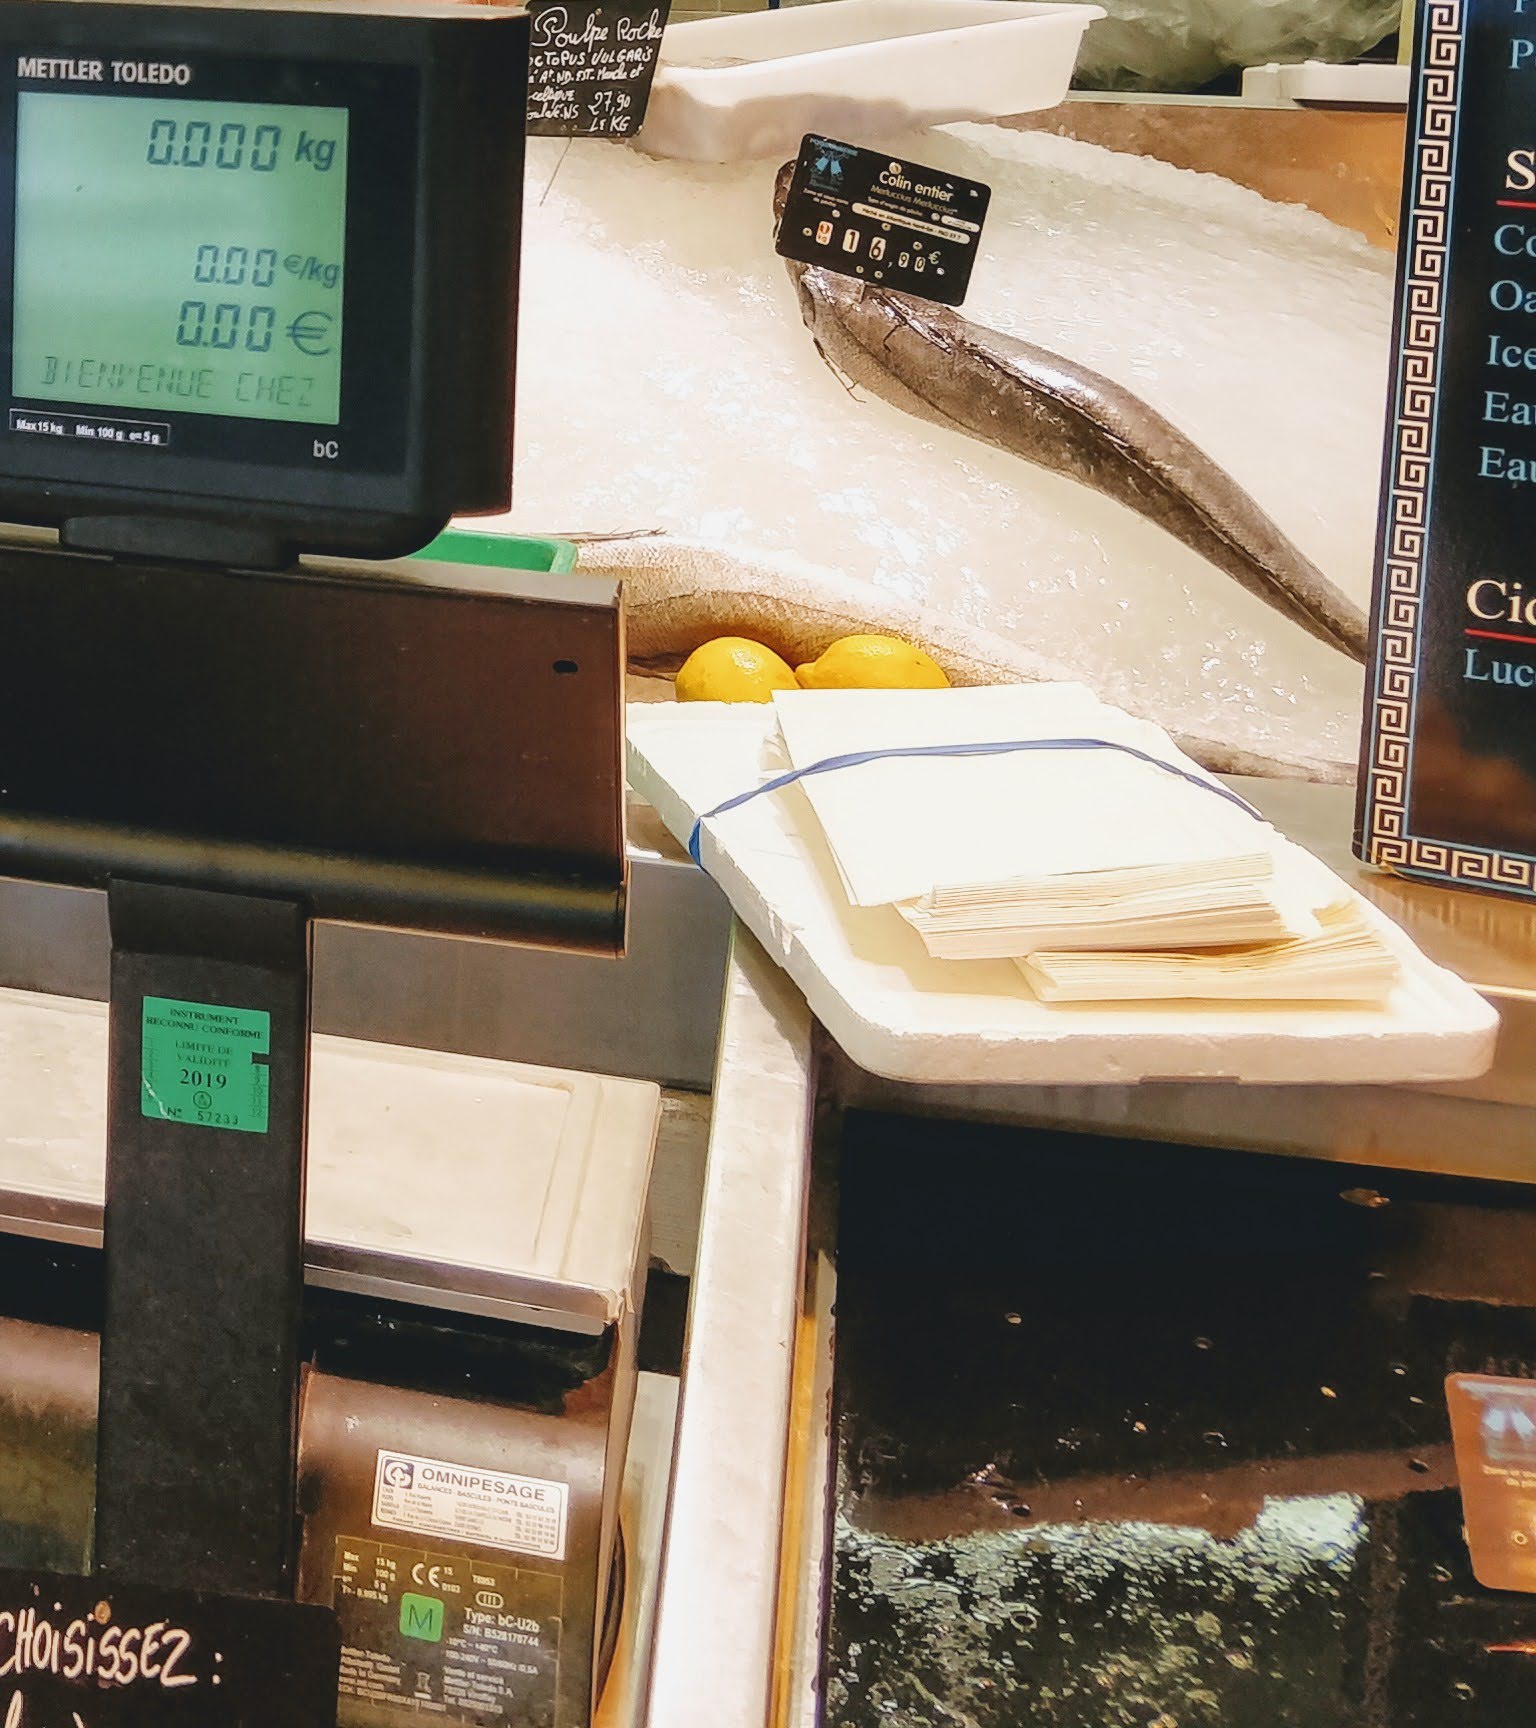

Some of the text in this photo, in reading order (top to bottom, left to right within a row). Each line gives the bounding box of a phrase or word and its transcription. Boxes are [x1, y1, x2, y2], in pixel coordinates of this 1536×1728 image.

[531, 6, 609, 53] Poulpe
[17, 57, 191, 86] METTLER TOLEDO
[588, 91, 631, 115] 27,90
[147, 119, 337, 172] 0.000 kg
[879, 171, 954, 203] Colin entier
[194, 244, 341, 290] 0.00 €/kg
[176, 301, 333, 356] 0.00 €
[1486, 335, 1536, 370] Ice
[42, 356, 313, 407] BIENVENUE CHEZ
[16, 419, 160, 444] Max 15 kg Min 100 g 5 g
[312, 440, 339, 459] bC
[145, 1016, 263, 1040] RECONNU CONFORME
[169, 1008, 240, 1025] INSTRUMENT
[175, 1040, 215, 1054] LIMITE
[180, 1069, 227, 1090] 2019
[417, 1483, 555, 1514] BALANCES BASCULES PONTS BASCULES
[422, 1467, 546, 1502] OMNIPESAGE
[409, 1604, 433, 1633] M
[464, 1607, 540, 1633] Type: bC-U2b
